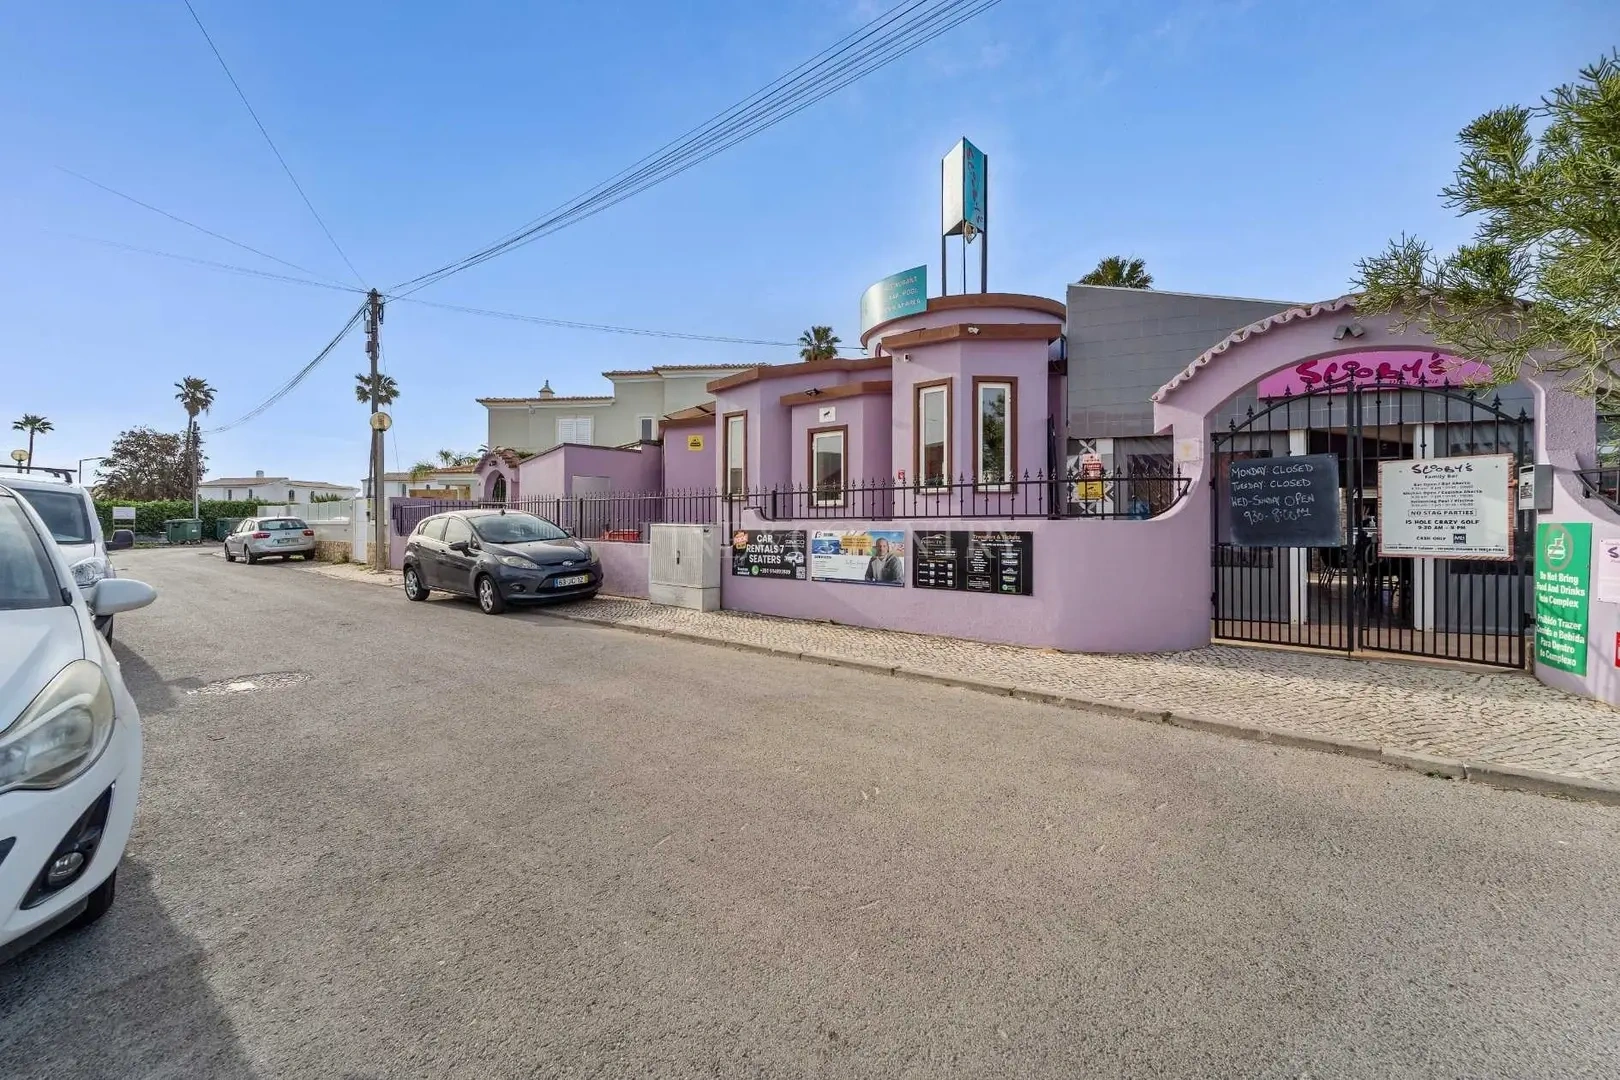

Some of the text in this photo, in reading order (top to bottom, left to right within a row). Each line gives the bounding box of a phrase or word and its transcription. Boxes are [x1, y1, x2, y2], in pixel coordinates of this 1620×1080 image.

[1272, 463, 1314, 475] CLOSED
[1269, 478, 1312, 488] CLOSED
[1284, 492, 1315, 507] OPEN
[757, 534, 773, 543] CAR
[746, 544, 785, 554] RENTALS 7
[749, 554, 781, 564] SEATERS
[1559, 573, 1579, 586] Bring
[1560, 585, 1585, 597] Drinks
[1549, 596, 1579, 608] Complex
[1557, 618, 1582, 630] Trazer
[1559, 630, 1585, 644] Bebida
[1552, 640, 1575, 653] Dentro
[1546, 650, 1577, 666] Complexo
